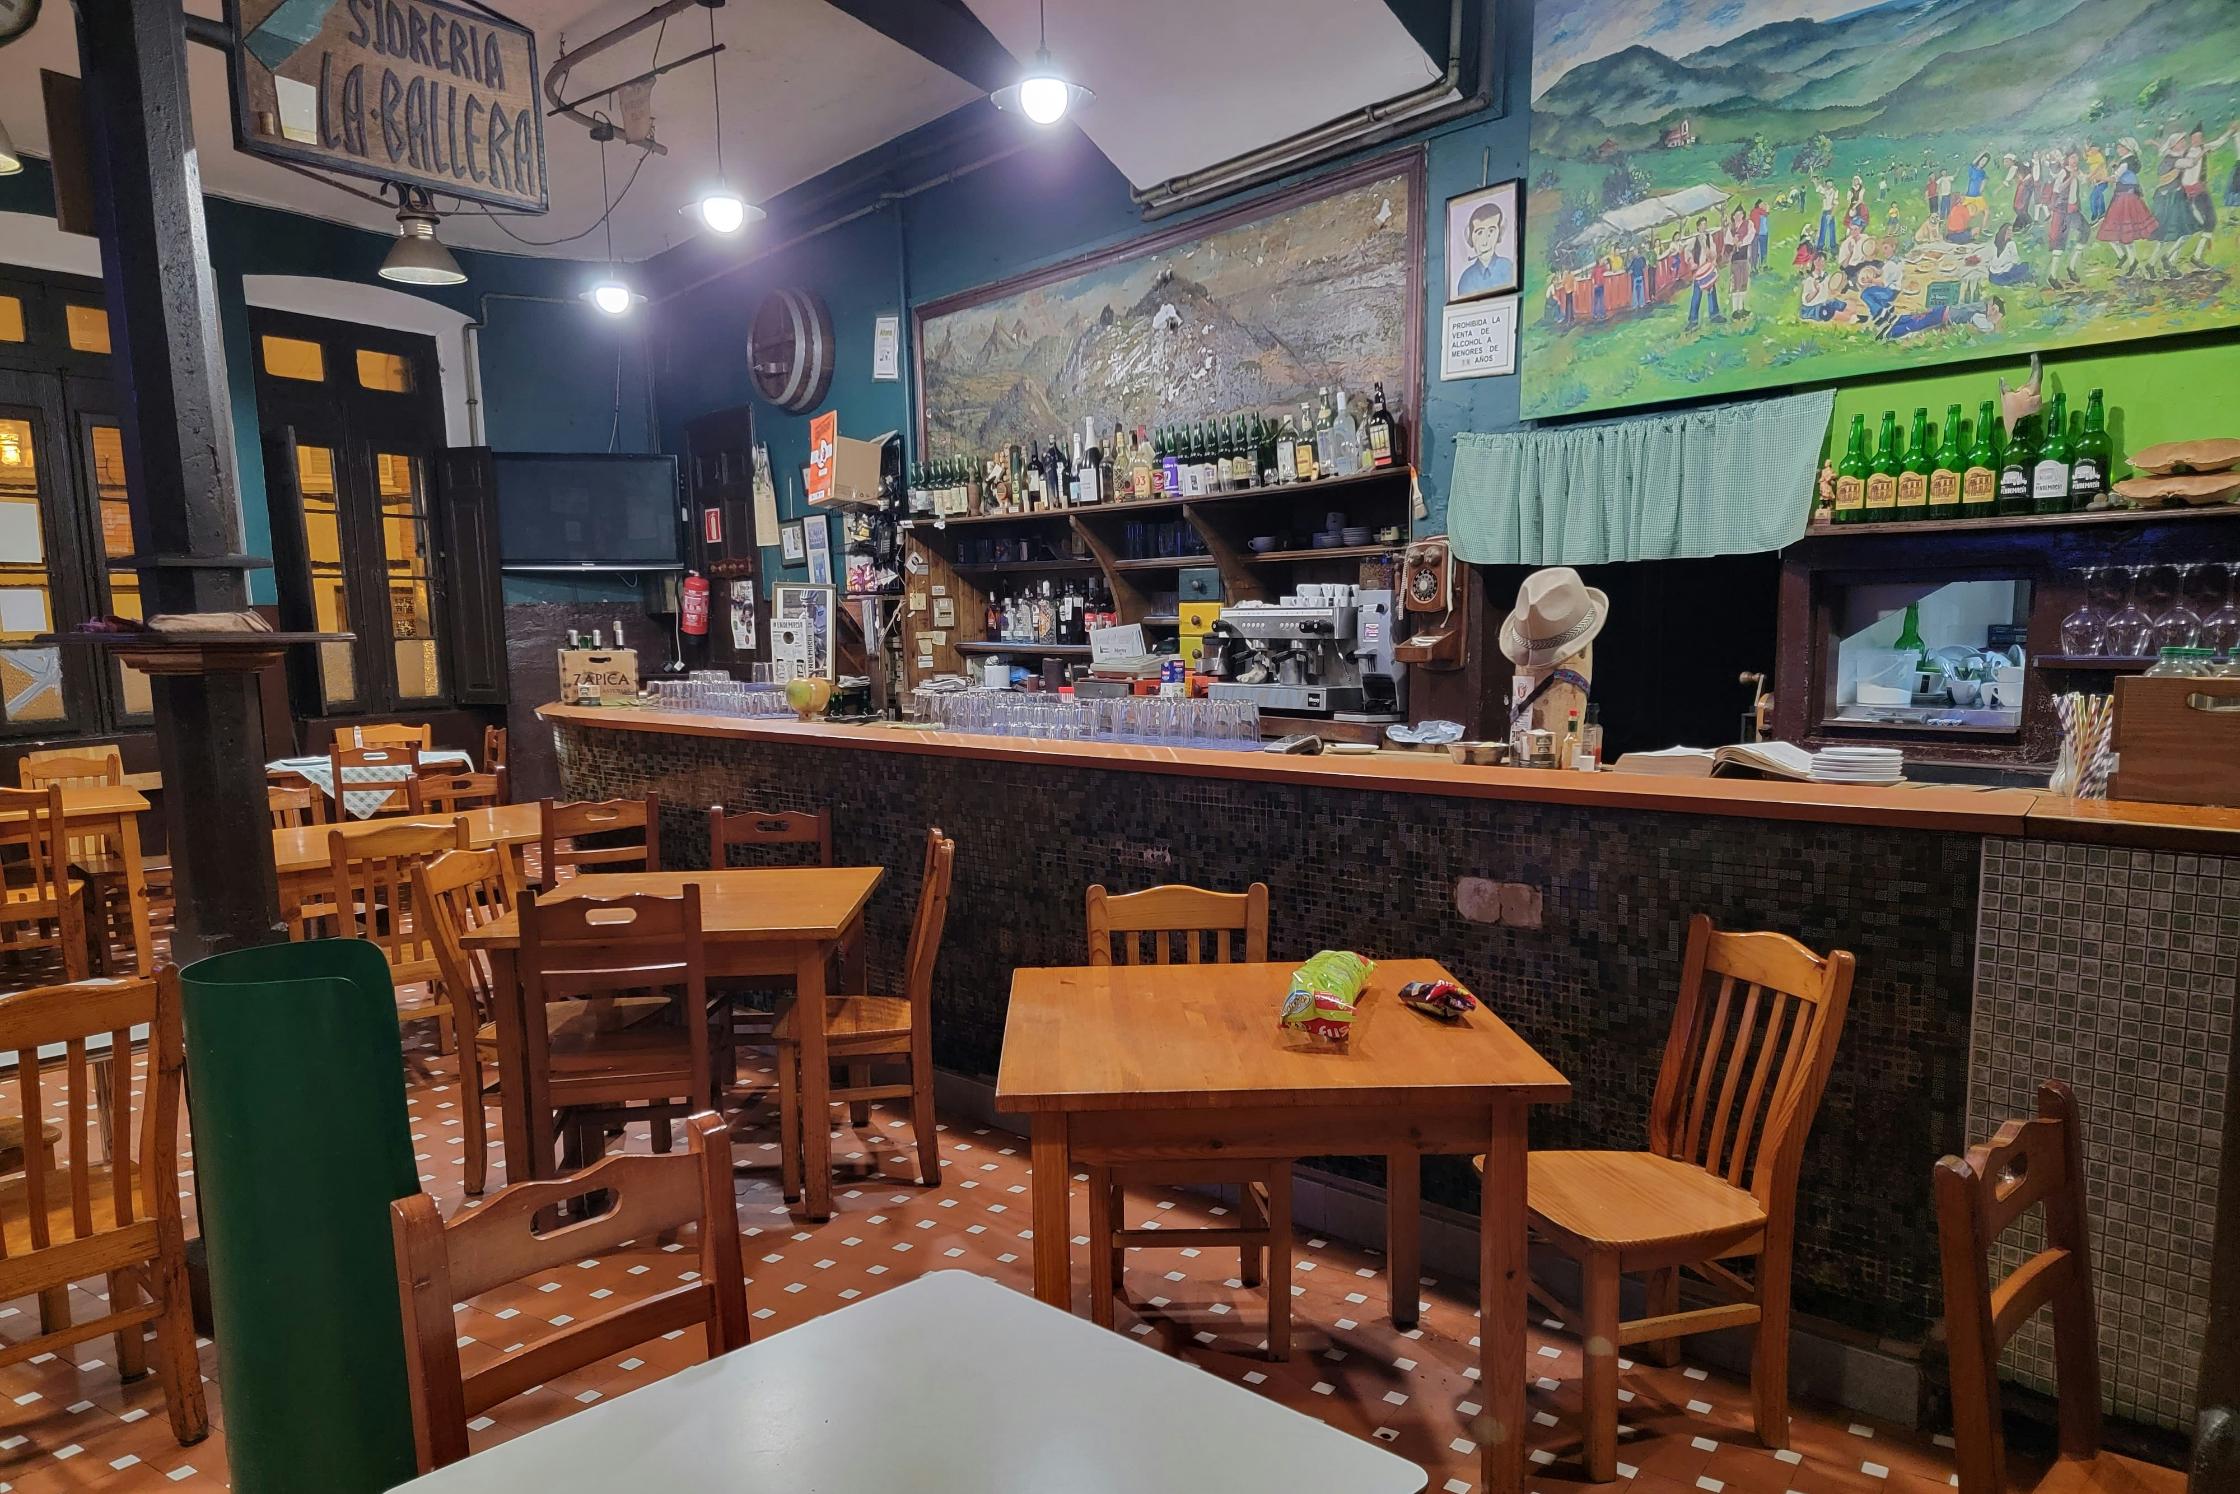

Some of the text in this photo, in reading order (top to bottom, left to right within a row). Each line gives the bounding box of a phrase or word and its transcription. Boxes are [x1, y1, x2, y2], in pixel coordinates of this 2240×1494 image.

[348, 0, 506, 90] SIDRERIA
[1452, 319, 1487, 330] PROHIBIDA
[1452, 330, 1472, 339] VENTA
[1452, 338, 1482, 348] ALCOHOL
[1452, 347, 1482, 357] MENORES
